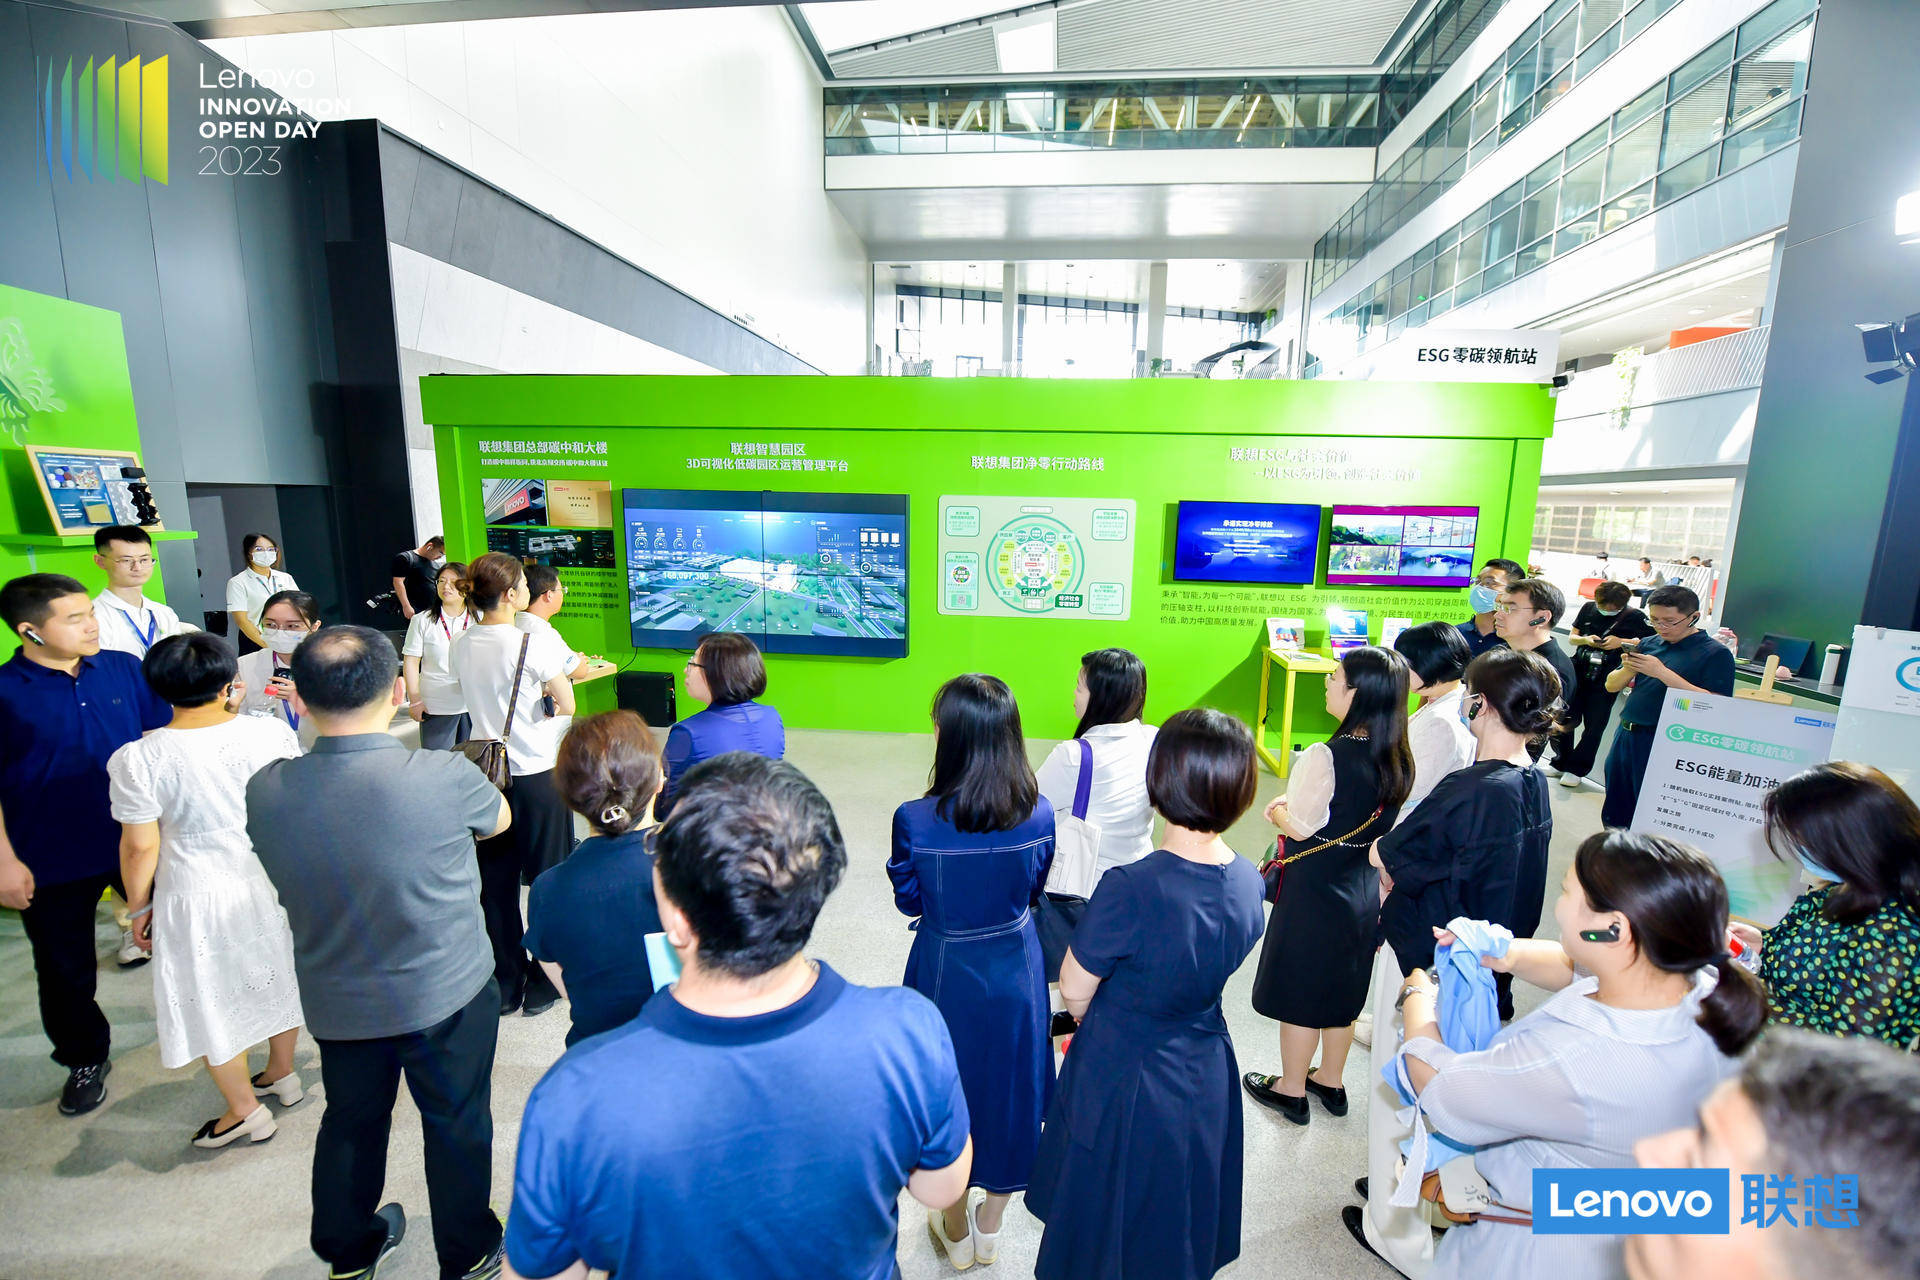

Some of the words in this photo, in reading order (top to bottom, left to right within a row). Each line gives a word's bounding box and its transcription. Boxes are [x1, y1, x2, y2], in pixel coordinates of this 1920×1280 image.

[479, 440, 608, 454] 联想集团总部碳中和大楼
[730, 442, 806, 456] 联想智慧园区
[686, 458, 849, 472] 3D可视化低碳园区运营管理平台
[971, 456, 1105, 471] 联想集团净零行动路线
